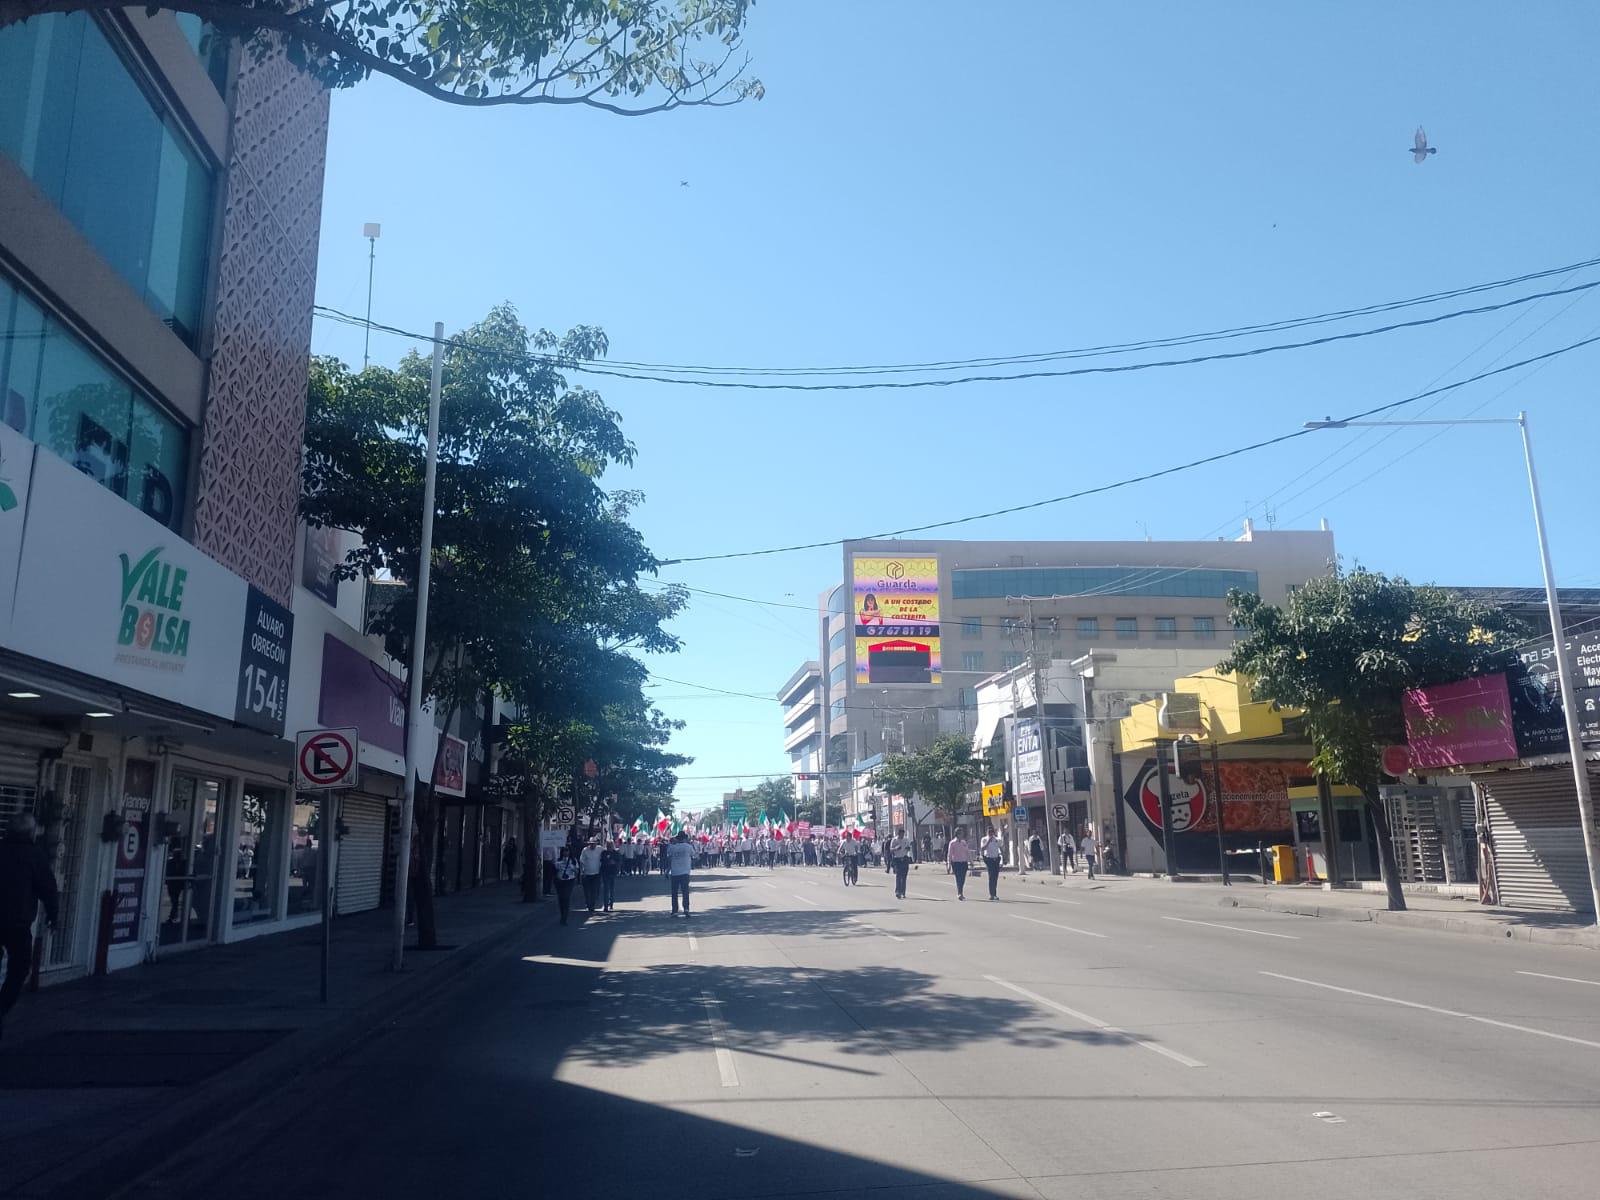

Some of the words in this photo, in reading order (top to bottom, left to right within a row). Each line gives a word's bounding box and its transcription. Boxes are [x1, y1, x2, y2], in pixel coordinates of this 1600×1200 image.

[118, 546, 188, 612] VALE
[877, 579, 917, 588] Guarda
[257, 605, 284, 638] ÁLVARO
[878, 626, 886, 636] 7
[886, 626, 901, 636] 67
[902, 626, 915, 636] 81
[919, 626, 932, 636] 19
[251, 633, 286, 664] OBREGÓN
[245, 664, 278, 719] 154
[1016, 734, 1039, 754] ENTA
[127, 833, 136, 853] E
